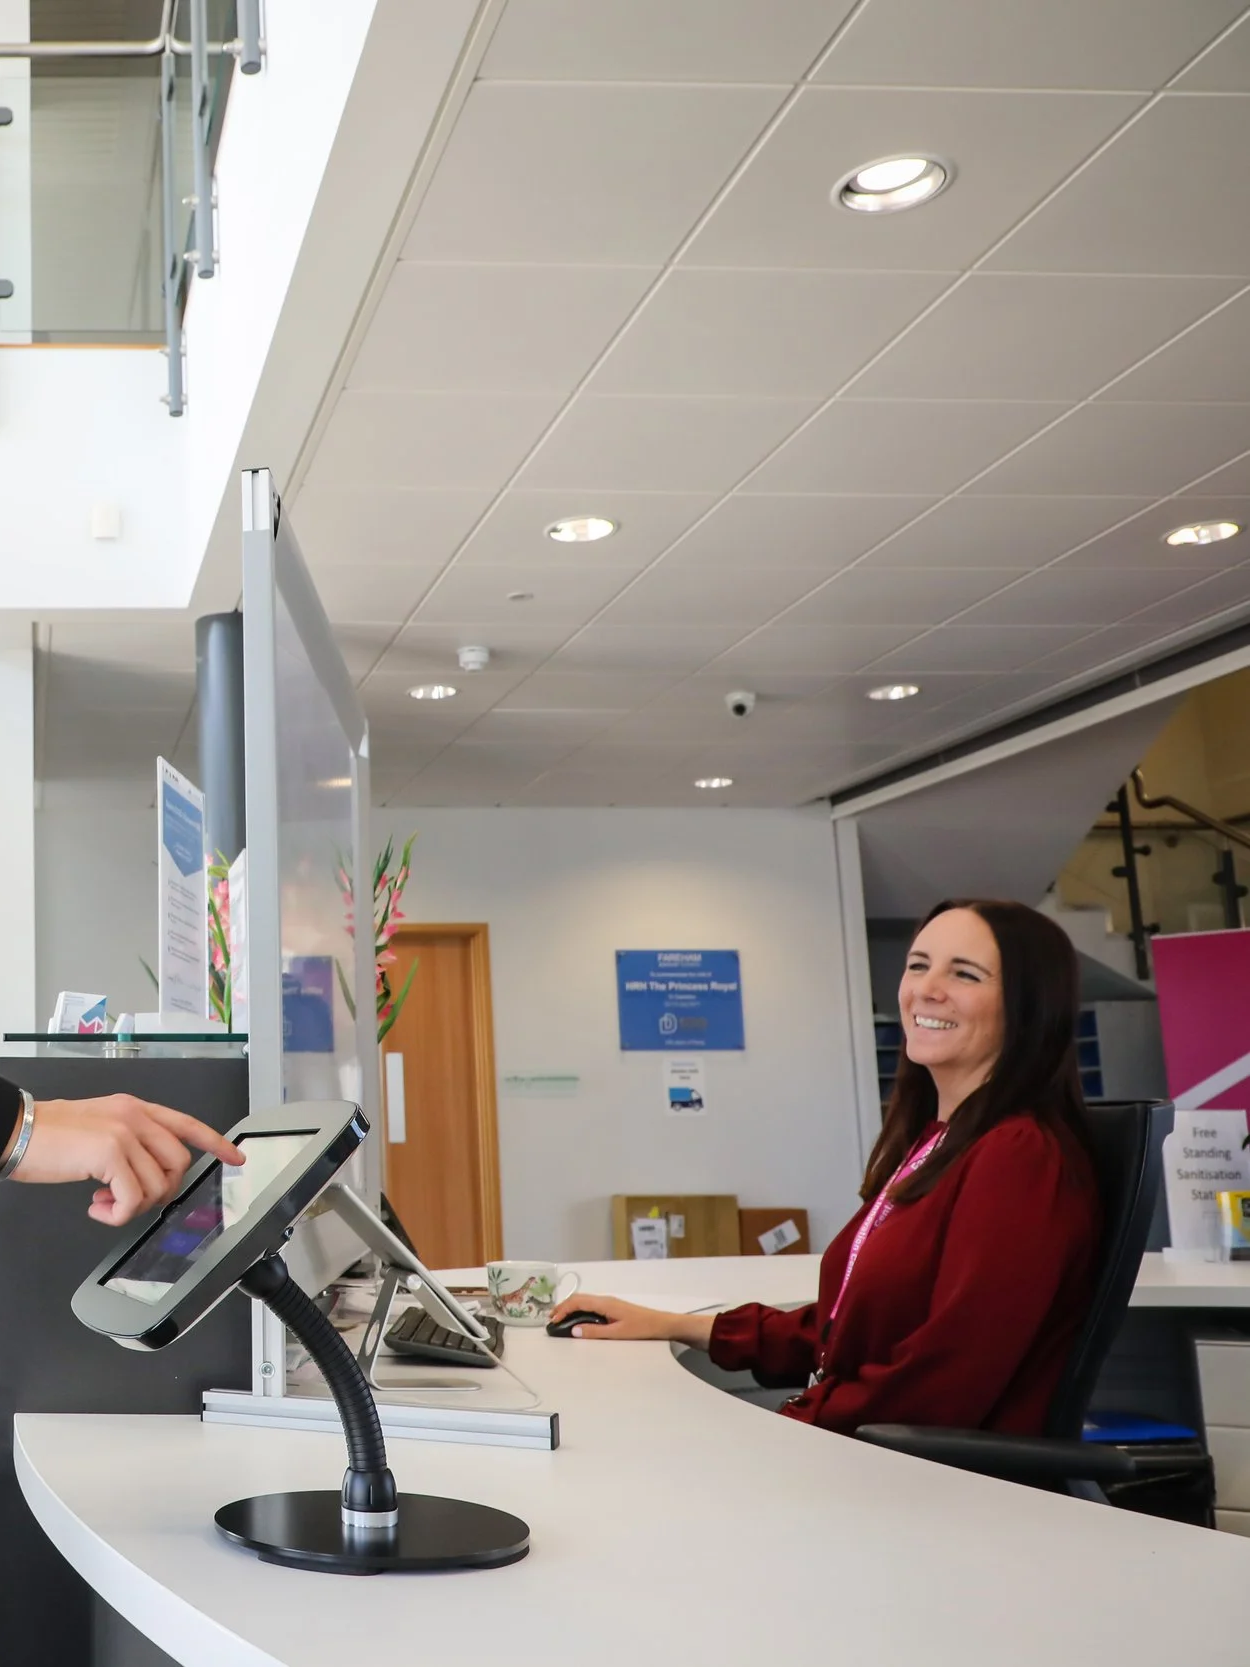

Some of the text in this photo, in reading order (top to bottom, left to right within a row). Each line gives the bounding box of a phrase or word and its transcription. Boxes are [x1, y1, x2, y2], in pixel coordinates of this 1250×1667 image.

[649, 981, 666, 991] The
[668, 982, 708, 991] Princess
[710, 981, 738, 993] Royal
[1192, 1127, 1217, 1138] Free
[1183, 1147, 1232, 1161] Standing
[1176, 1168, 1242, 1180] Sanitisation
[1191, 1189, 1217, 1201] Stati
